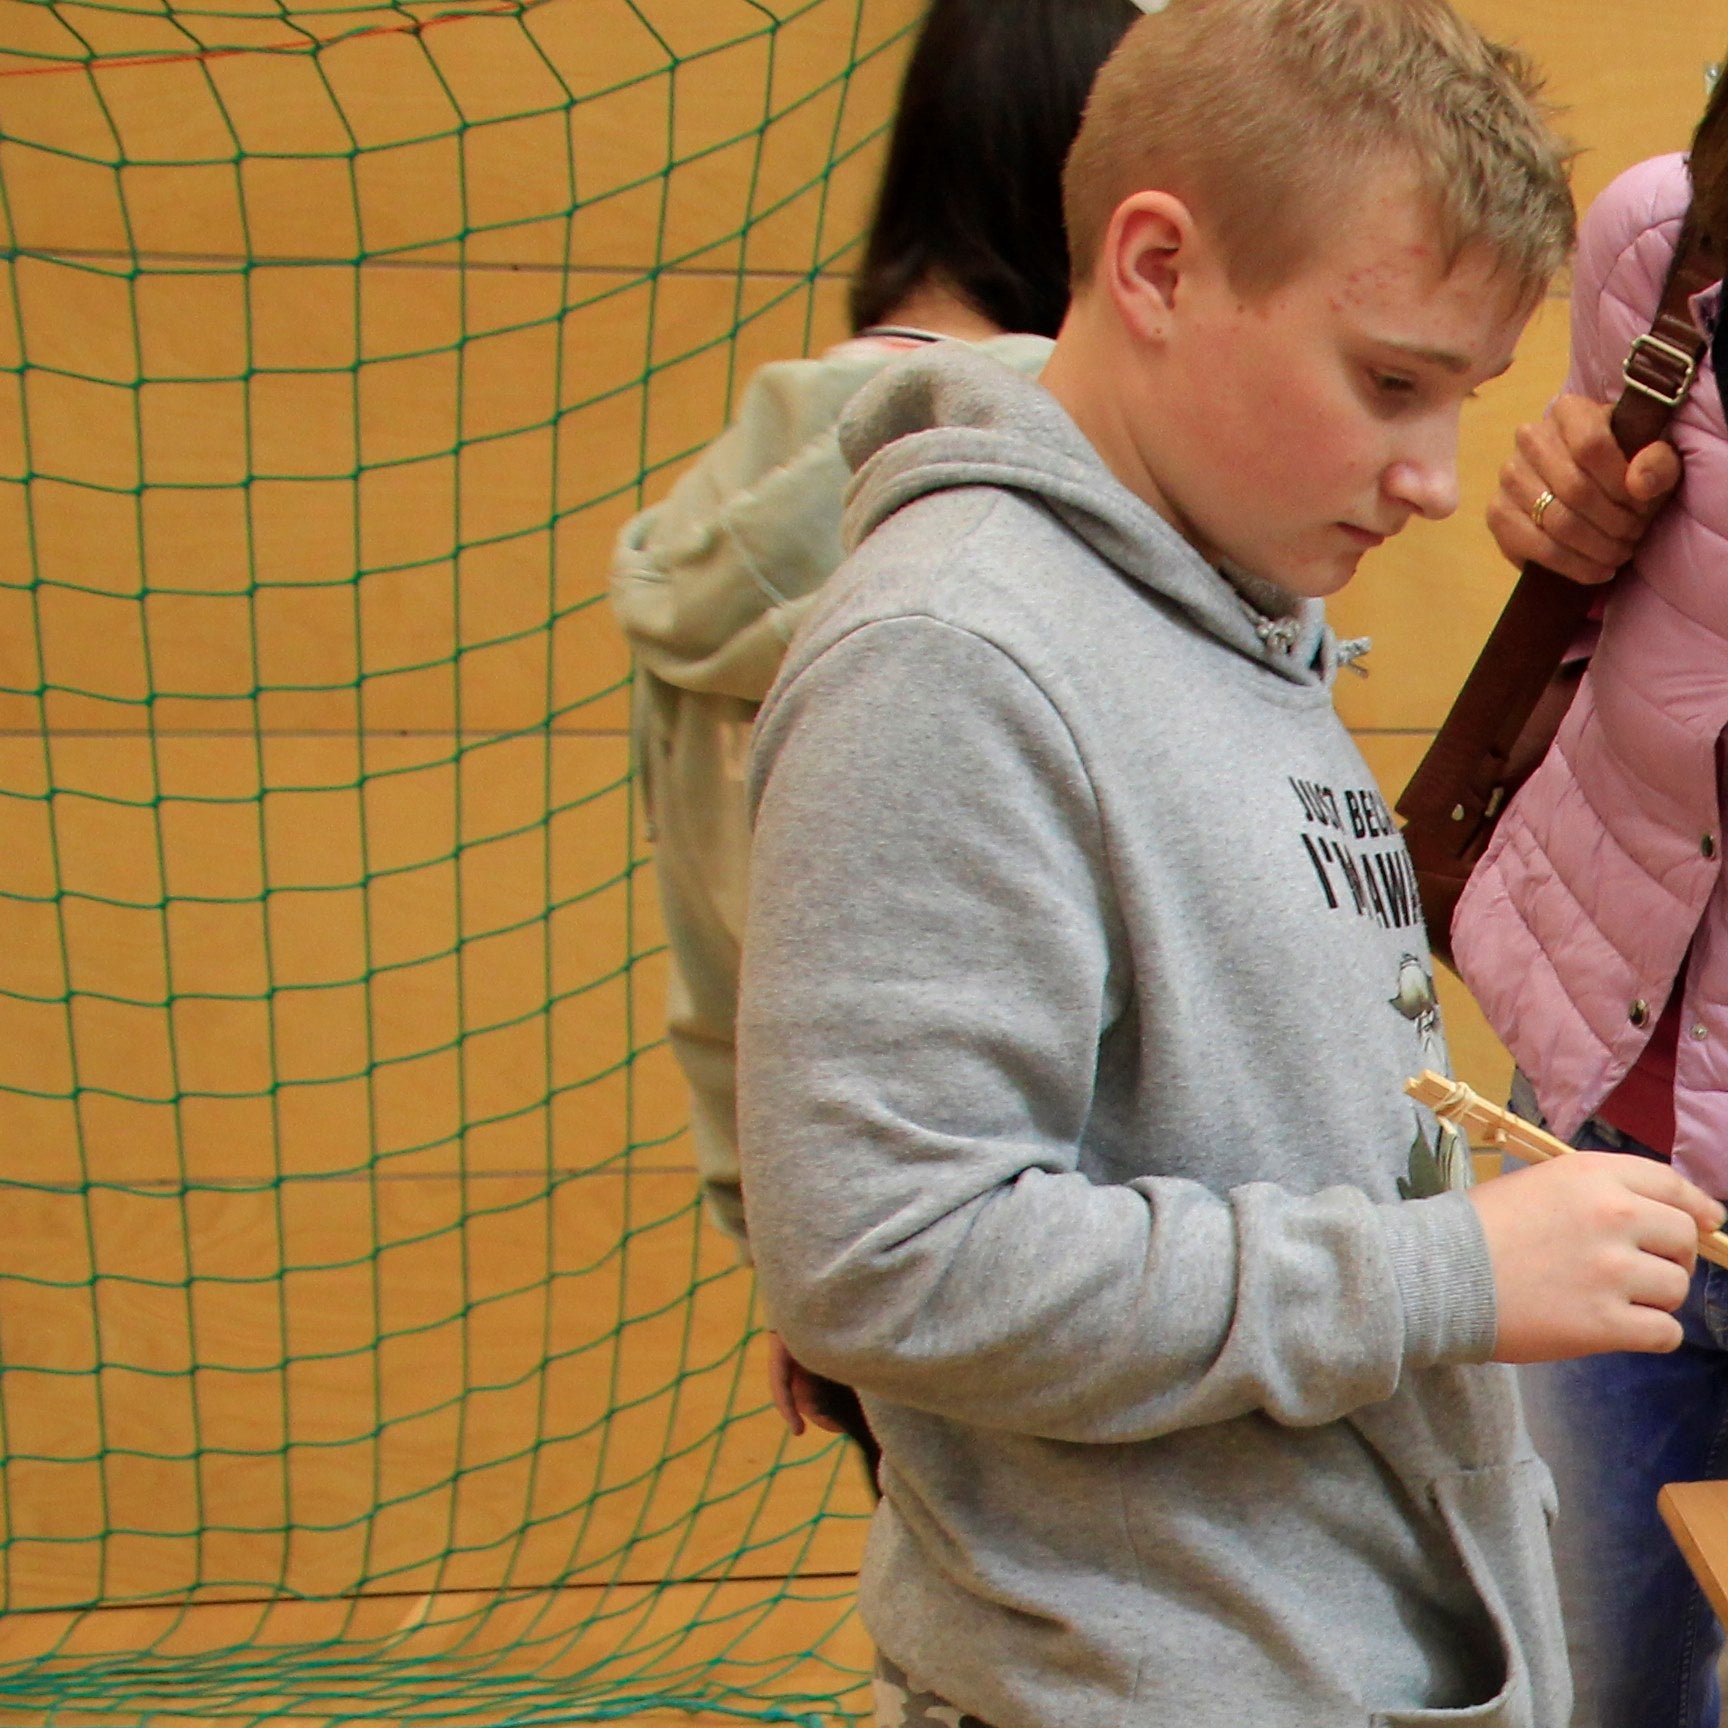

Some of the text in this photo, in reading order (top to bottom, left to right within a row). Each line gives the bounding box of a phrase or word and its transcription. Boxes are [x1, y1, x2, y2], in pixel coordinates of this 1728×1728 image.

[1289, 776, 1398, 839] JUST BEC
[1301, 833, 1373, 921] I'M
